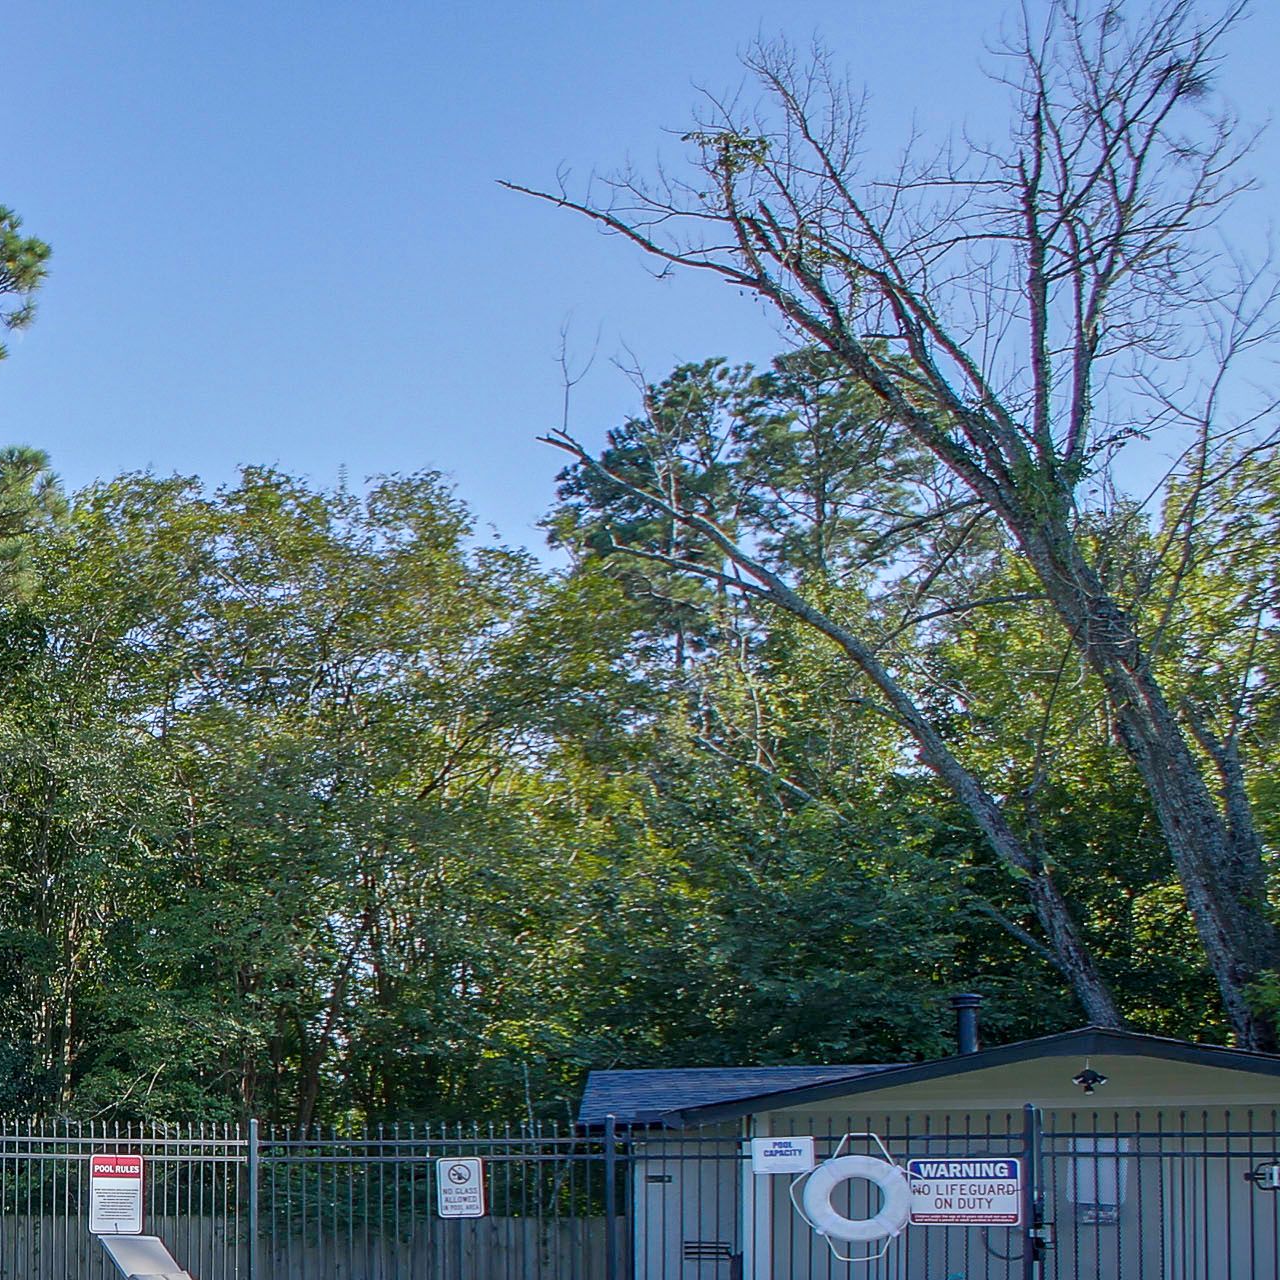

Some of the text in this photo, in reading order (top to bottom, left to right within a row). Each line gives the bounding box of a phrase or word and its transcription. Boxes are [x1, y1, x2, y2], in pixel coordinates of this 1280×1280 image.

[764, 1149, 802, 1157] CAPACITY
[94, 1165, 139, 1173] POOL RULES
[919, 1163, 1009, 1178] WARNING
[443, 1187, 478, 1195] NO GLASS
[912, 1184, 1015, 1195] NO LIFEGUARD
[445, 1195, 477, 1203] ALLOWED
[934, 1198, 993, 1210] ON DUTY
